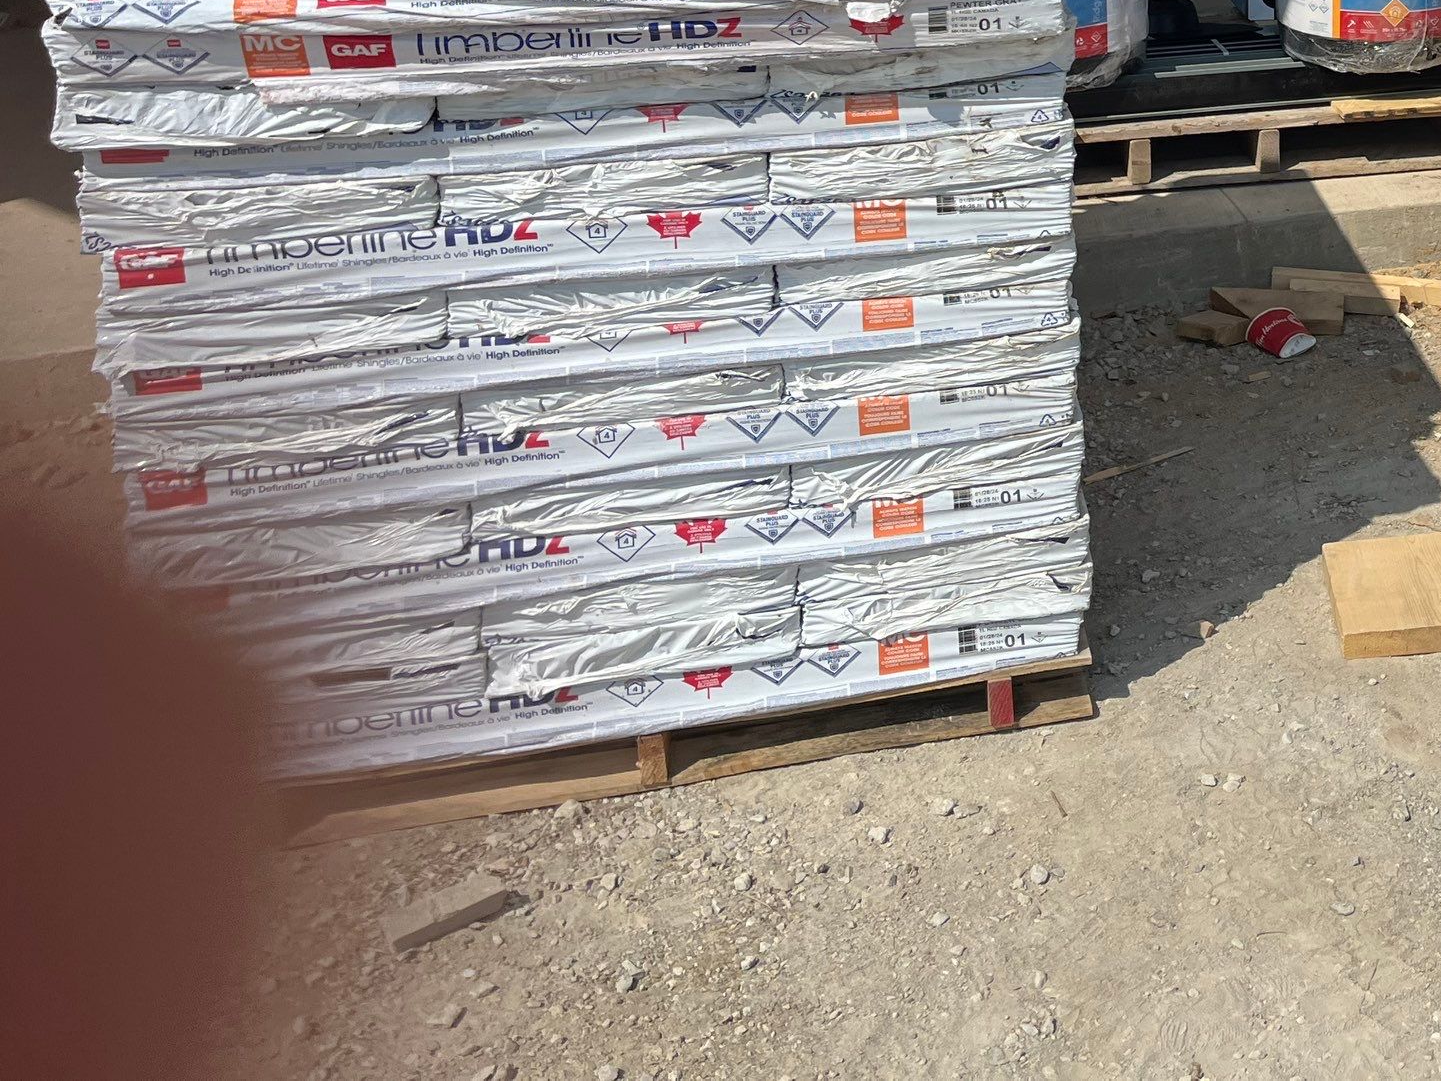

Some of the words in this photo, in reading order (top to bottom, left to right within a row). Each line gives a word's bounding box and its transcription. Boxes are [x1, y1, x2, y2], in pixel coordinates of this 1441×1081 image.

[950, 0, 993, 8] PEWTER
[979, 17, 1002, 31] 01
[243, 35, 301, 52] MC
[331, 44, 386, 57] GAF
[977, 82, 1000, 95] 01
[459, 135, 485, 144] High
[486, 129, 533, 140] Definition
[985, 197, 1008, 210] 01
[209, 267, 235, 277] High
[473, 247, 498, 258] High
[500, 244, 548, 254] Definition
[486, 349, 510, 359] High
[512, 346, 560, 357] Definition
[986, 385, 1009, 396] 01
[230, 486, 255, 497] High
[484, 456, 509, 467] High
[511, 452, 560, 463] Definition
[1000, 489, 1022, 503] 01
[505, 563, 529, 573] High
[531, 559, 578, 569] Definition
[1004, 633, 1026, 647] 01
[515, 710, 539, 720] High
